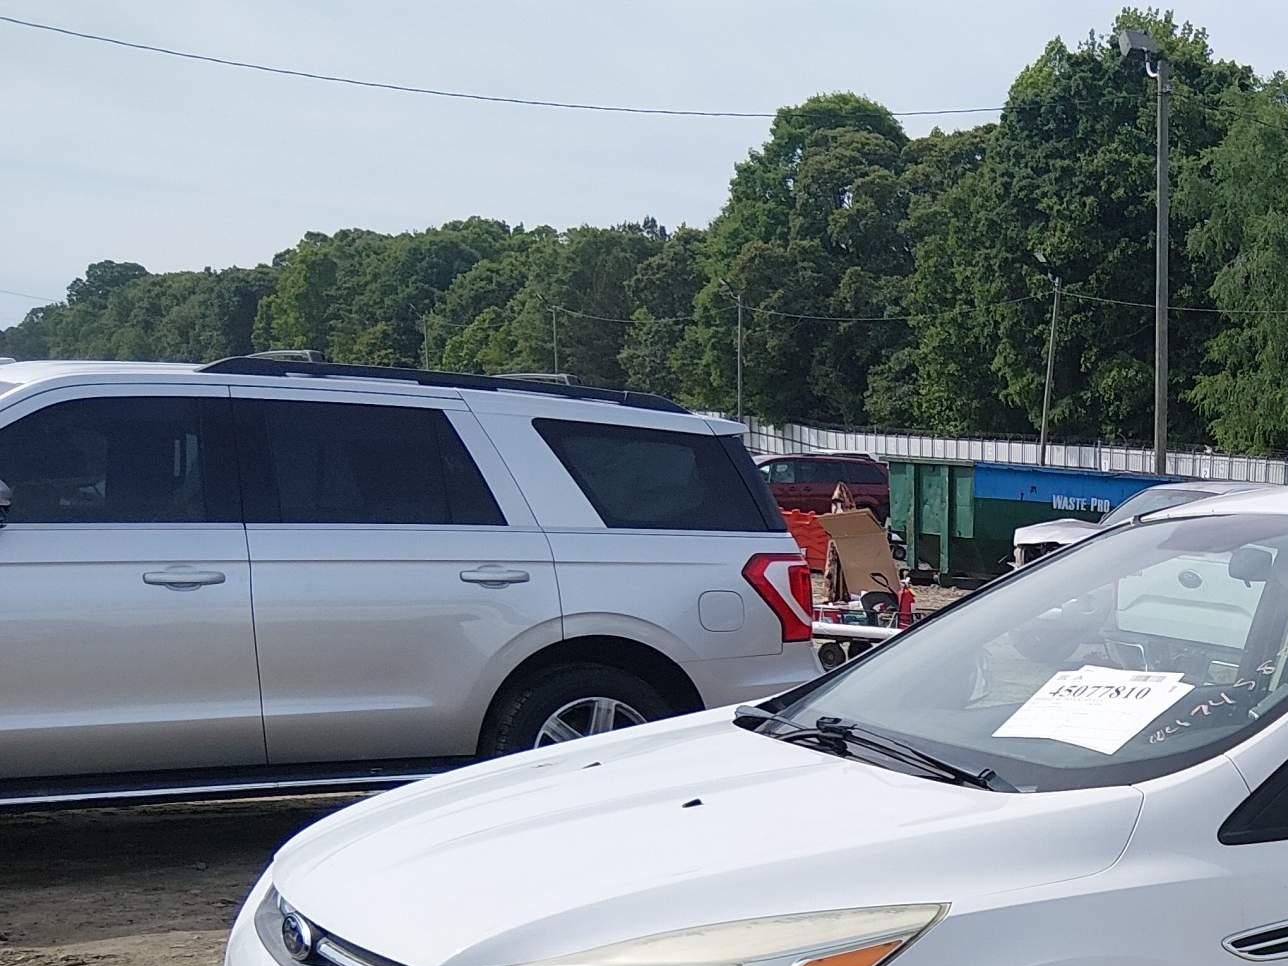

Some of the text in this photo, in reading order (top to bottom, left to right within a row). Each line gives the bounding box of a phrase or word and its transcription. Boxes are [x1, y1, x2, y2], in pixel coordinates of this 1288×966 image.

[1052, 494, 1110, 513] WASTE PRO
[1049, 685, 1152, 700] 45077810
